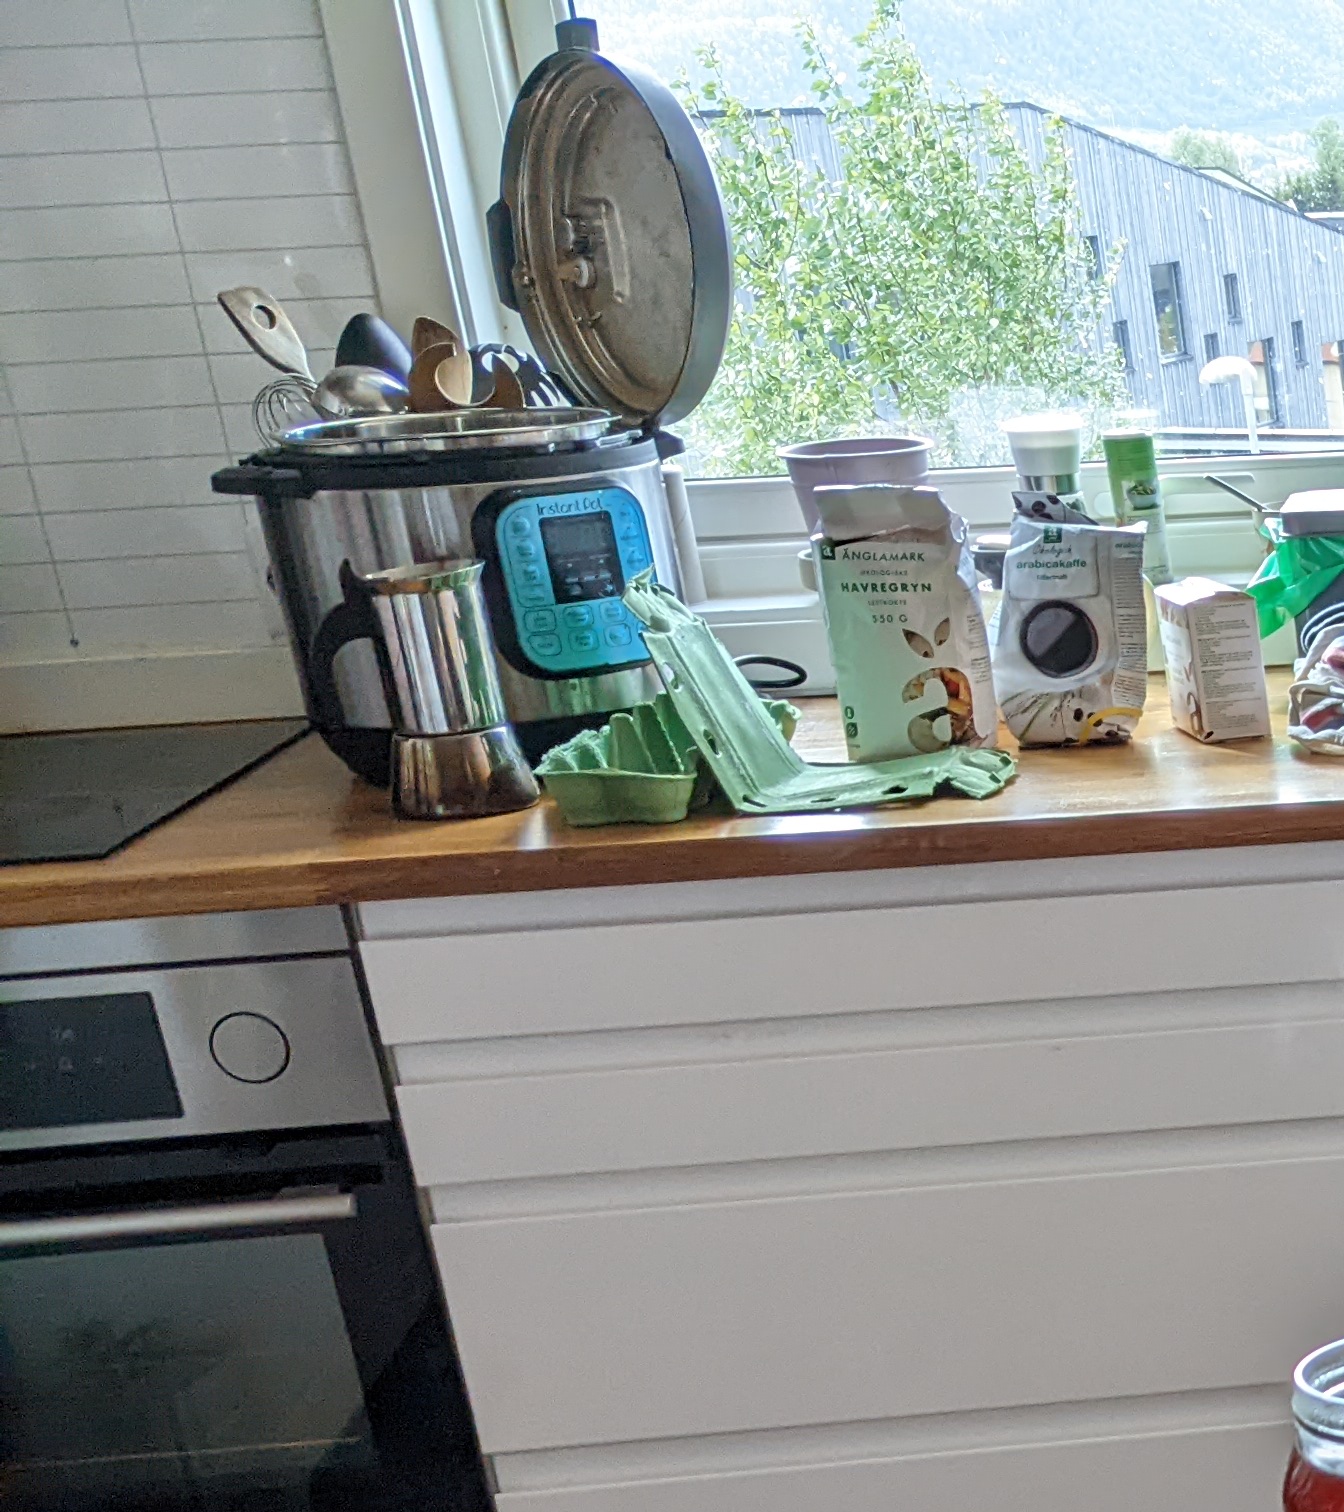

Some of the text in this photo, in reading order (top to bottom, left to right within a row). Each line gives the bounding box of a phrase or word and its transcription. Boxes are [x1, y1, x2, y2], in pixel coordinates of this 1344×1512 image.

[536, 497, 603, 515] Instant Pot
[1016, 559, 1087, 569] arabicakaffe
[841, 582, 932, 593] HAVREGRYN
[872, 614, 908, 623] 550 G
